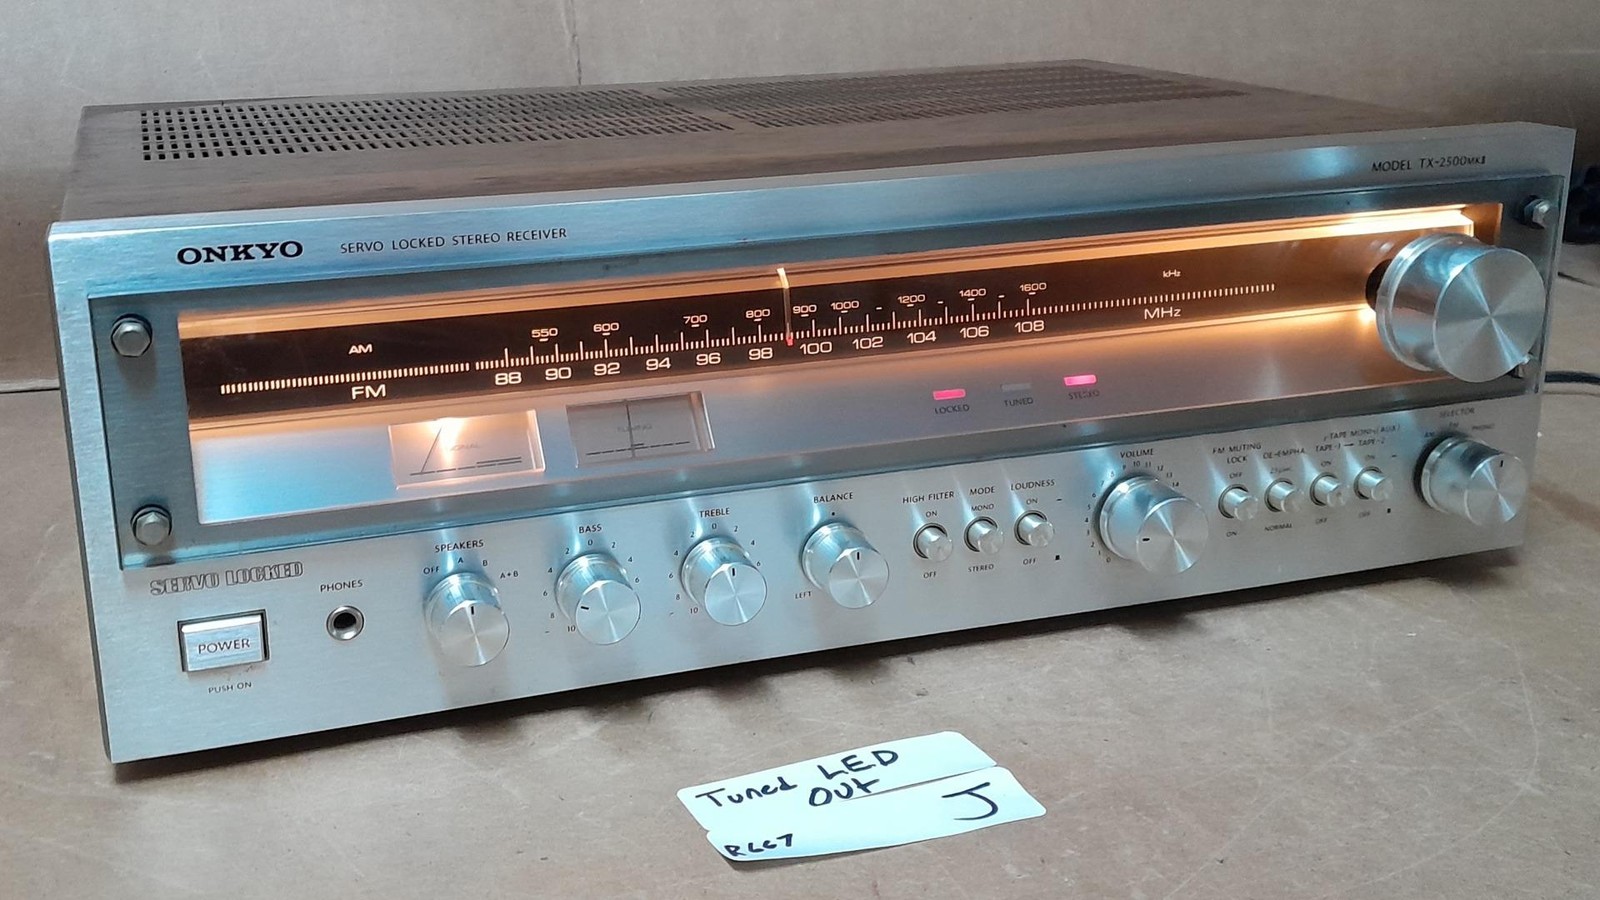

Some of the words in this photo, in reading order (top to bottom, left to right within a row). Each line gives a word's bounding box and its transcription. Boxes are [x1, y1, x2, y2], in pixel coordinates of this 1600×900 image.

[1371, 160, 1412, 172] MODEL
[340, 240, 385, 254] SERVO
[391, 236, 446, 251] LOCKED
[452, 232, 501, 247] STEREO
[506, 228, 567, 243] RECEIVER
[177, 239, 304, 266] ONKYO
[531, 327, 559, 338] 550
[593, 322, 620, 333] 600
[683, 314, 708, 325] 700
[745, 308, 771, 319] 800
[792, 304, 818, 314] 900
[830, 300, 860, 311] 1000
[897, 293, 926, 304] 1200
[958, 288, 987, 298] 1400
[1019, 282, 1047, 292] 1600
[1144, 307, 1182, 320] MHz
[348, 343, 374, 355] AM
[495, 372, 522, 386] 88
[545, 367, 572, 380] 90
[593, 362, 621, 376] 92
[645, 357, 672, 371] 94
[695, 352, 721, 365] 96
[748, 347, 774, 361] 98
[799, 341, 833, 355] 100
[852, 336, 884, 350] 102
[906, 330, 937, 344] 104
[959, 325, 990, 339] 106
[1014, 319, 1045, 333] 108
[351, 384, 386, 400] FM
[1004, 397, 1034, 407] TUNED
[935, 404, 970, 415] LOCKED
[1120, 448, 1154, 459] VOLUME
[1229, 443, 1262, 453] MUTING
[1227, 456, 1247, 464] LOCK
[969, 486, 996, 496] MODE
[1010, 479, 1055, 491] LOUDNESS
[813, 492, 854, 504] BALANCE
[902, 495, 925, 504] HIGH
[928, 491, 955, 501] FILTER
[1026, 497, 1038, 505] ON
[699, 507, 731, 518] TREBLE
[971, 503, 995, 512] MONO
[925, 510, 938, 518] ON
[578, 524, 602, 534] BASS
[434, 539, 484, 553] SPEAKERS
[1022, 558, 1037, 566] OFF
[423, 566, 440, 574] OFF
[967, 564, 995, 573] STEREO
[150, 572, 220, 596] SERVO
[225, 561, 304, 587] LOCKED
[923, 571, 937, 579] OFF
[320, 579, 364, 593] PHONES
[795, 591, 812, 599] LEFT
[198, 638, 251, 654] POWER
[208, 685, 233, 694] PUSH
[237, 681, 252, 689] ON
[695, 776, 798, 807] Tuned
[817, 750, 899, 780] LED
[941, 781, 999, 821] J
